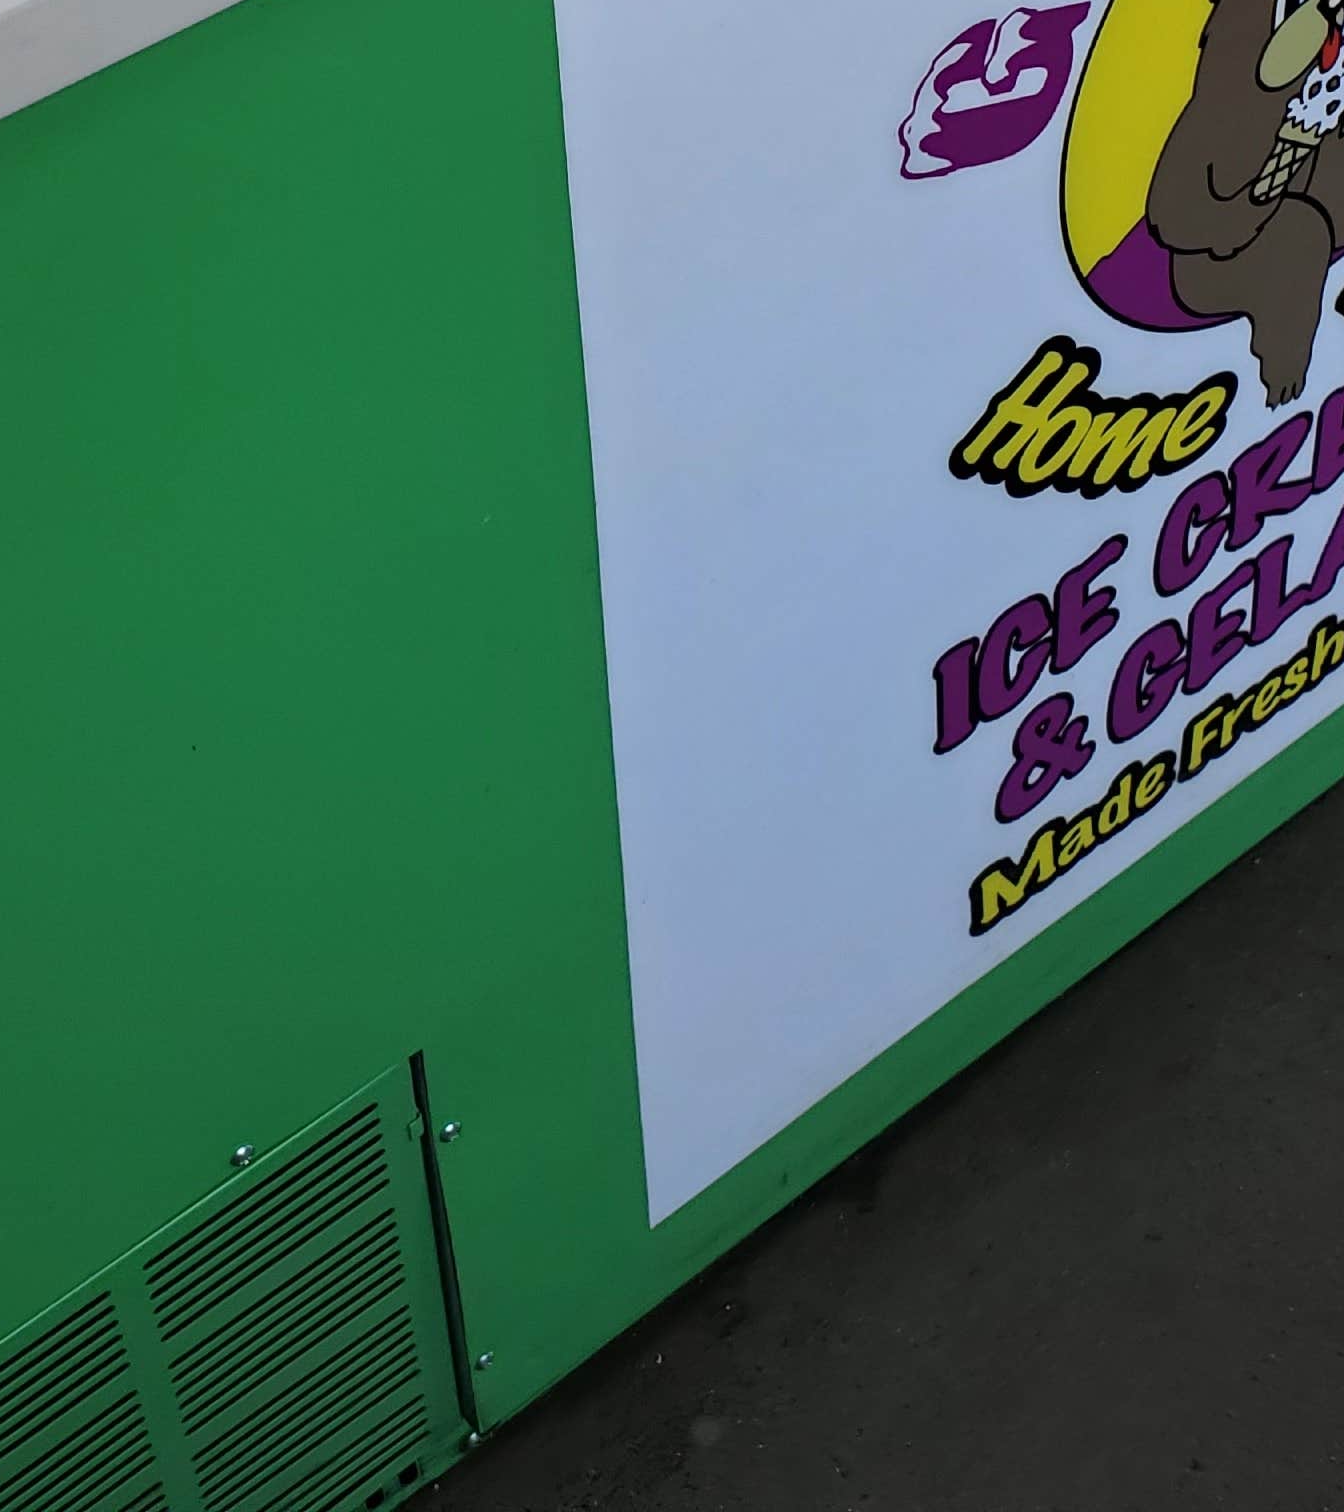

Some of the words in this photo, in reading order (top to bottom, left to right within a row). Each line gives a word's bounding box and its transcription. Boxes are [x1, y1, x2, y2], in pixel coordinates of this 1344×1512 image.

[949, 334, 1239, 500] Home
[932, 533, 1129, 756] ICE
[968, 750, 1178, 937] Made
[994, 690, 1098, 823] &
